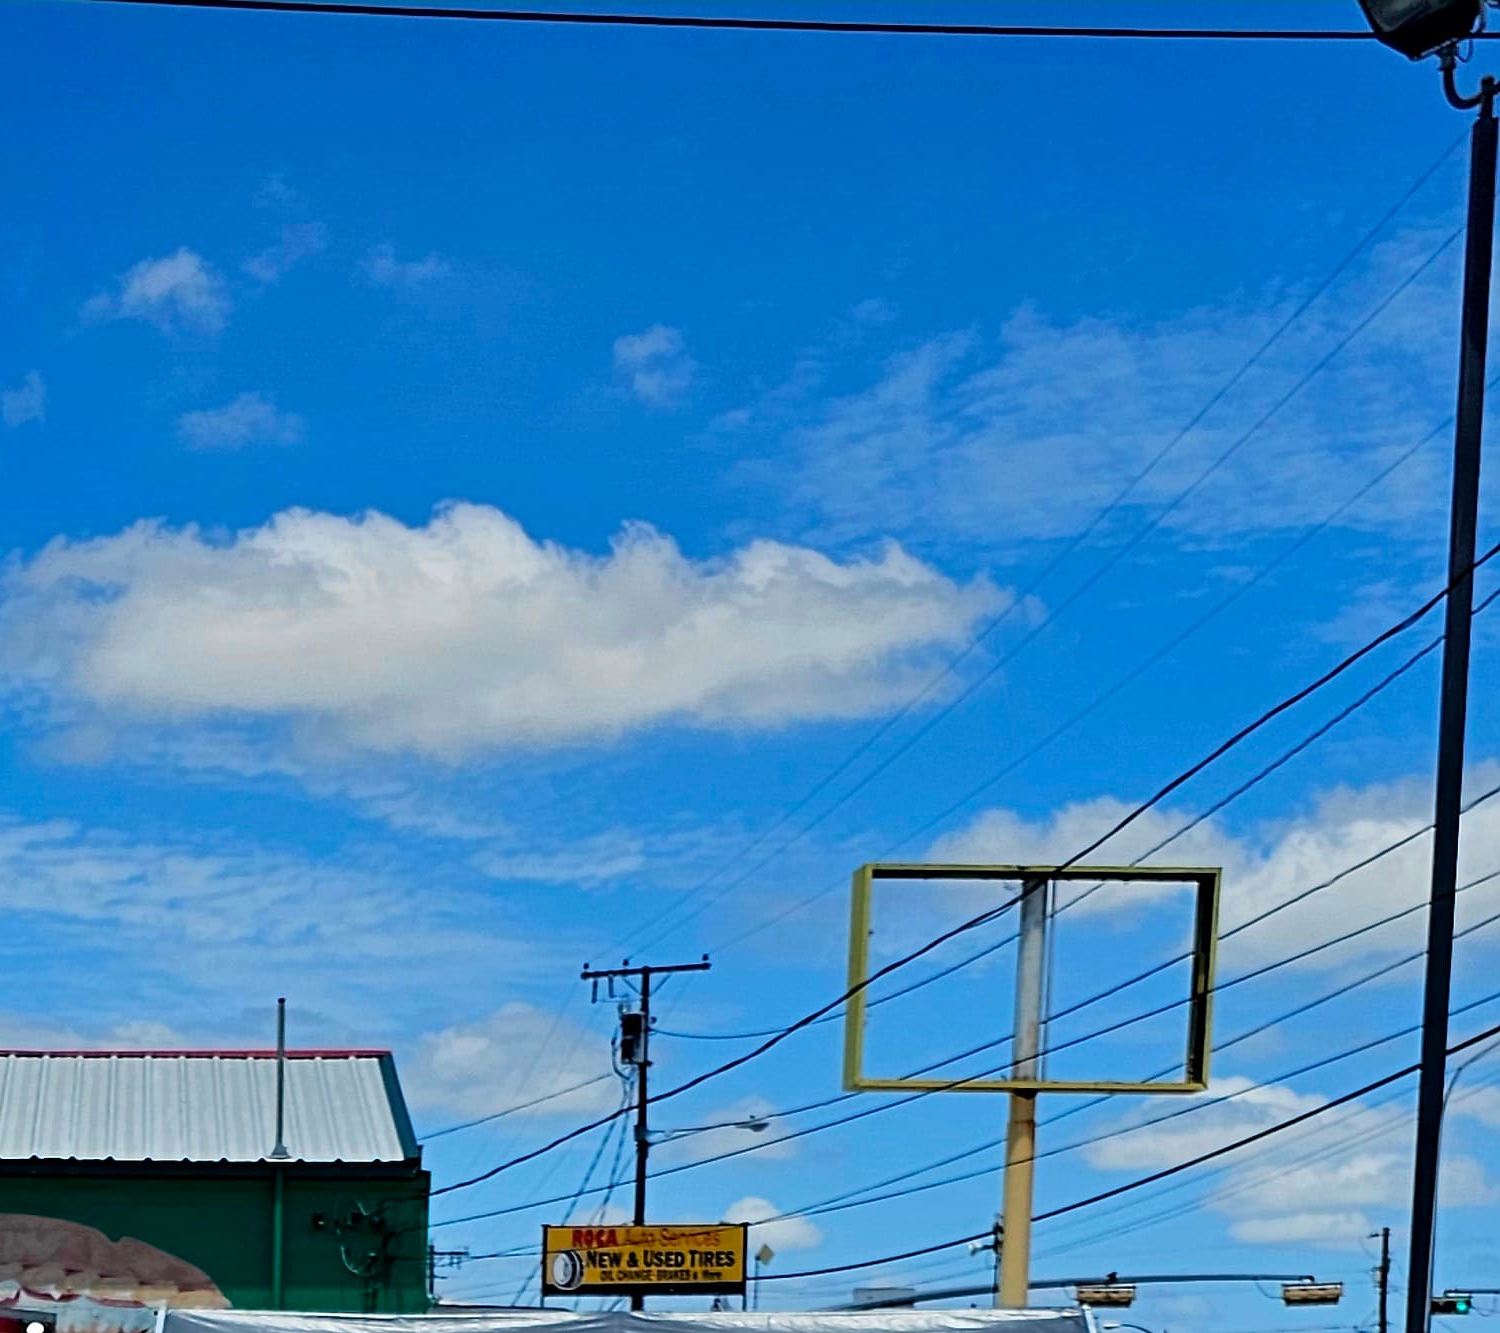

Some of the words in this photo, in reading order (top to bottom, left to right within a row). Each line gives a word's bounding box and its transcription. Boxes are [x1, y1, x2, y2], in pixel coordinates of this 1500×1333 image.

[587, 1250, 622, 1268] NEW
[627, 1251, 638, 1267] &
[643, 1250, 685, 1267] USED
[689, 1249, 735, 1267] TIRES
